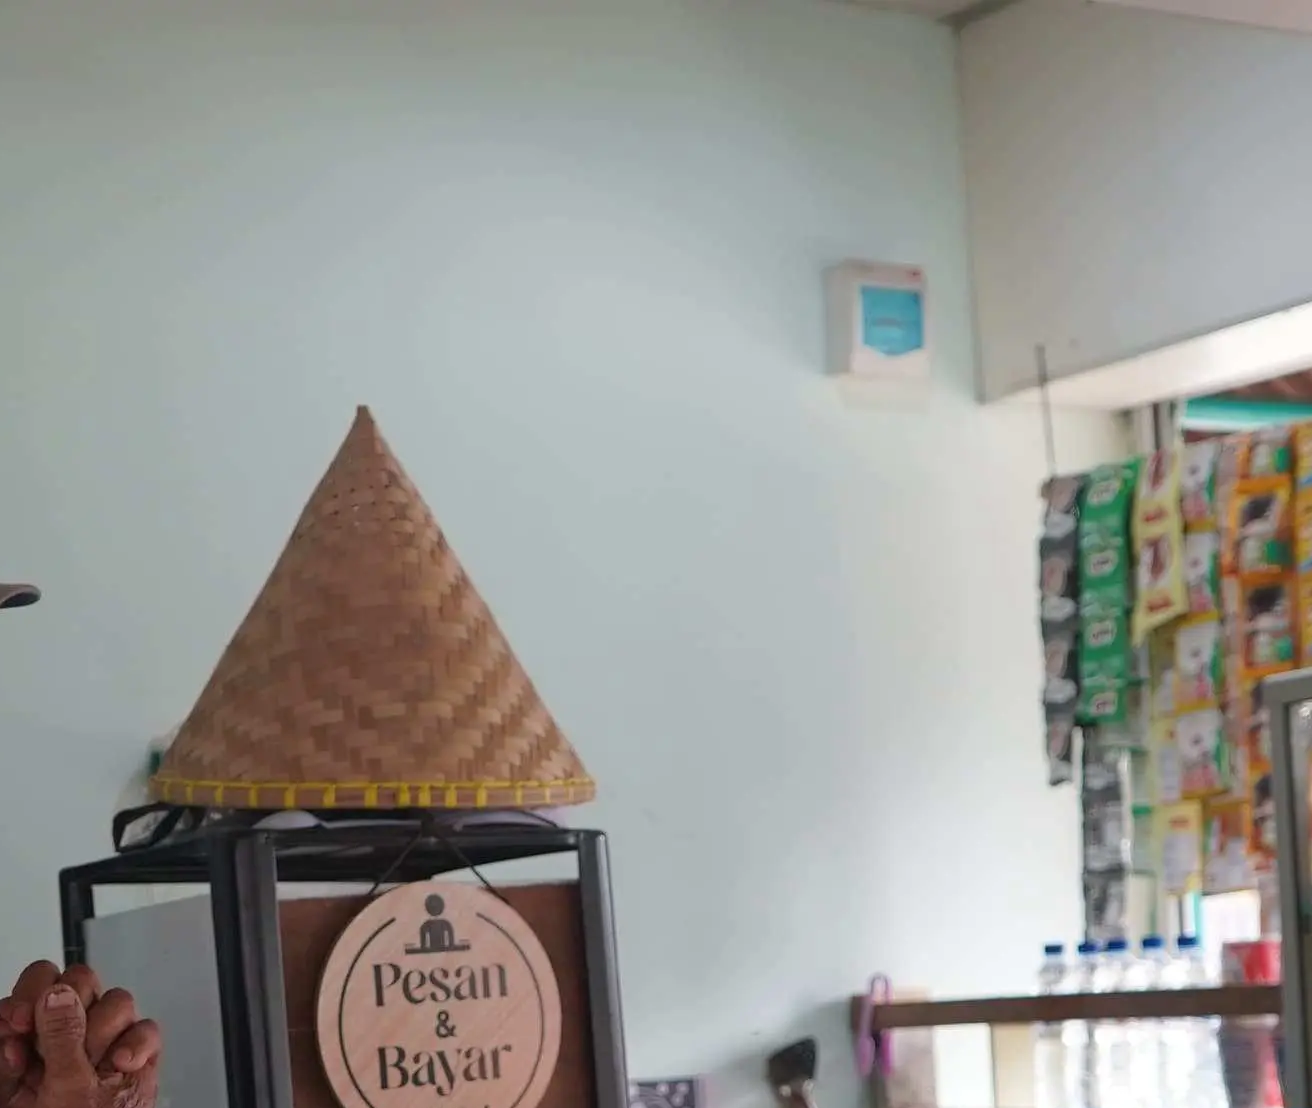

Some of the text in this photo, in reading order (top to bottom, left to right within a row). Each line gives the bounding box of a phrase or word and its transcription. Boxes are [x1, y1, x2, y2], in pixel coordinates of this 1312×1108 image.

[372, 962, 508, 1008] Pesan
[434, 1010, 457, 1039] &
[376, 1044, 513, 1098] Bayar
